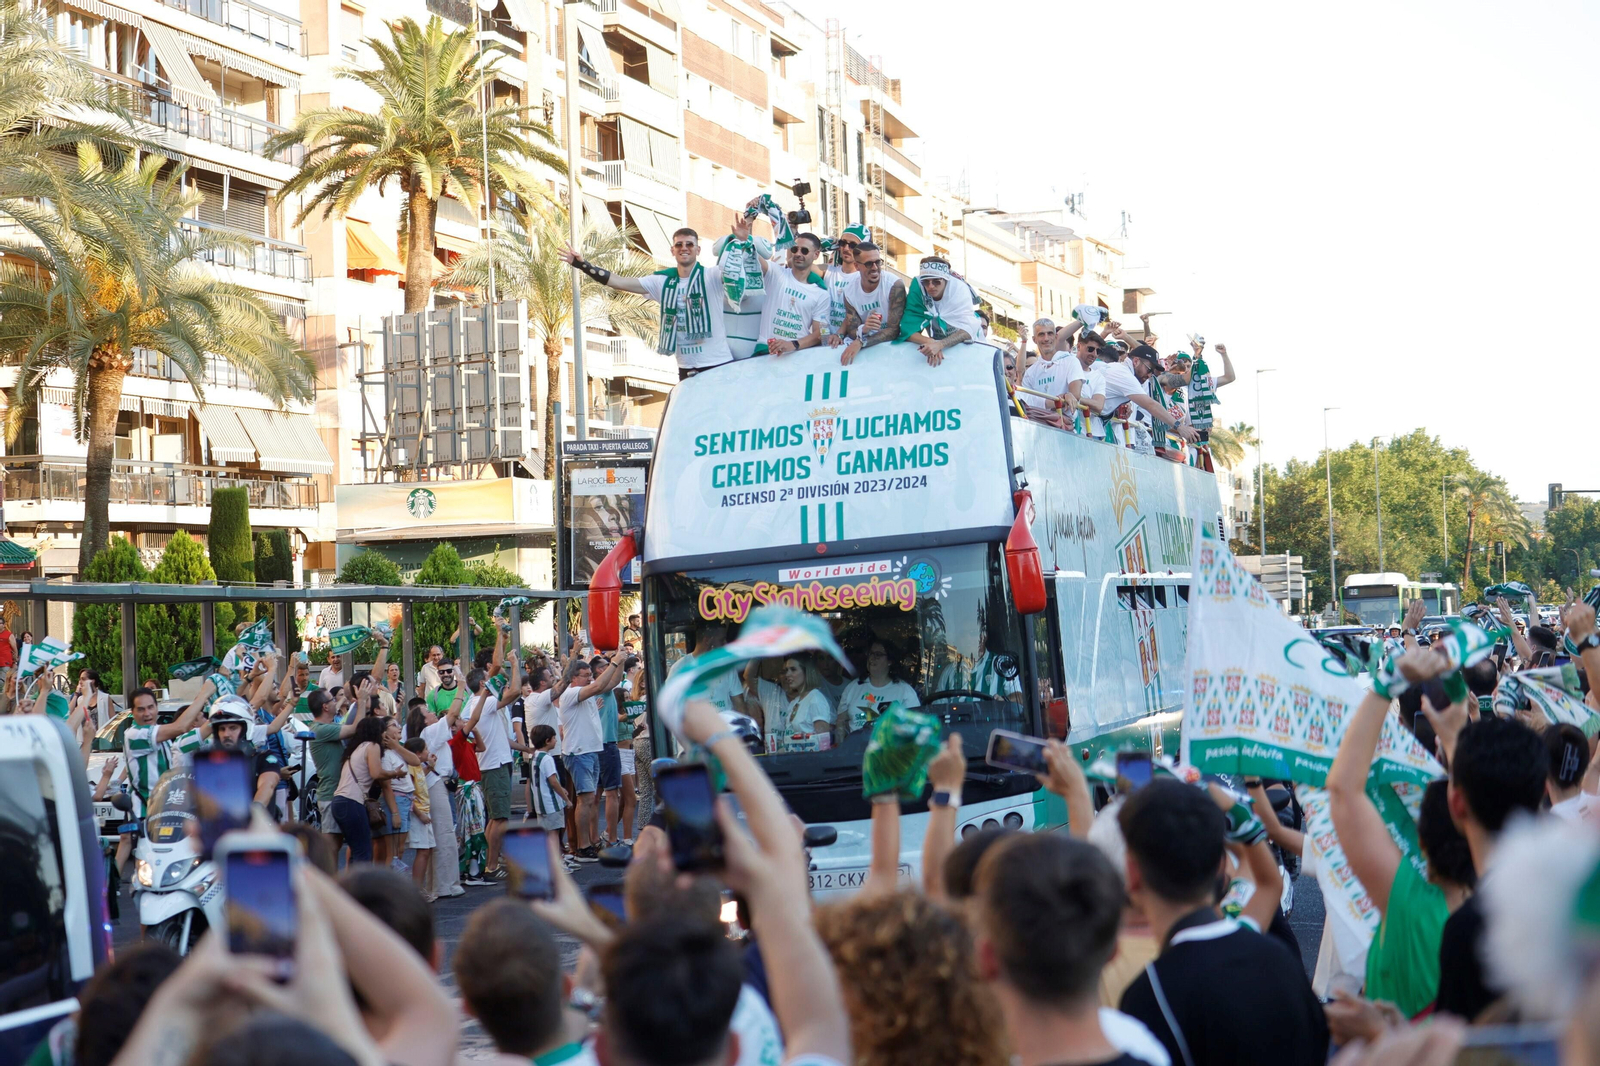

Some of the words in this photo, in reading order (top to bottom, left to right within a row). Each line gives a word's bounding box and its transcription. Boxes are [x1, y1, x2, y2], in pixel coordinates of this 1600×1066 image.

[773, 327, 798, 339] CREIMOS
[694, 424, 804, 457] SENTIMOS
[841, 408, 962, 441] LUCHAMOS
[566, 443, 587, 451] PARADA
[602, 442, 621, 450] PUERTA
[621, 441, 649, 450] GALLEGOS
[712, 455, 811, 489] CREIMOS
[837, 442, 949, 476] GANAMOS
[721, 490, 776, 507] ASCENSO
[797, 479, 849, 500] DIVISIÓN
[853, 475, 928, 494] 2023/2024
[788, 563, 888, 580] Worldwide
[698, 586, 752, 624] City
[1241, 743, 1284, 762] infinita
